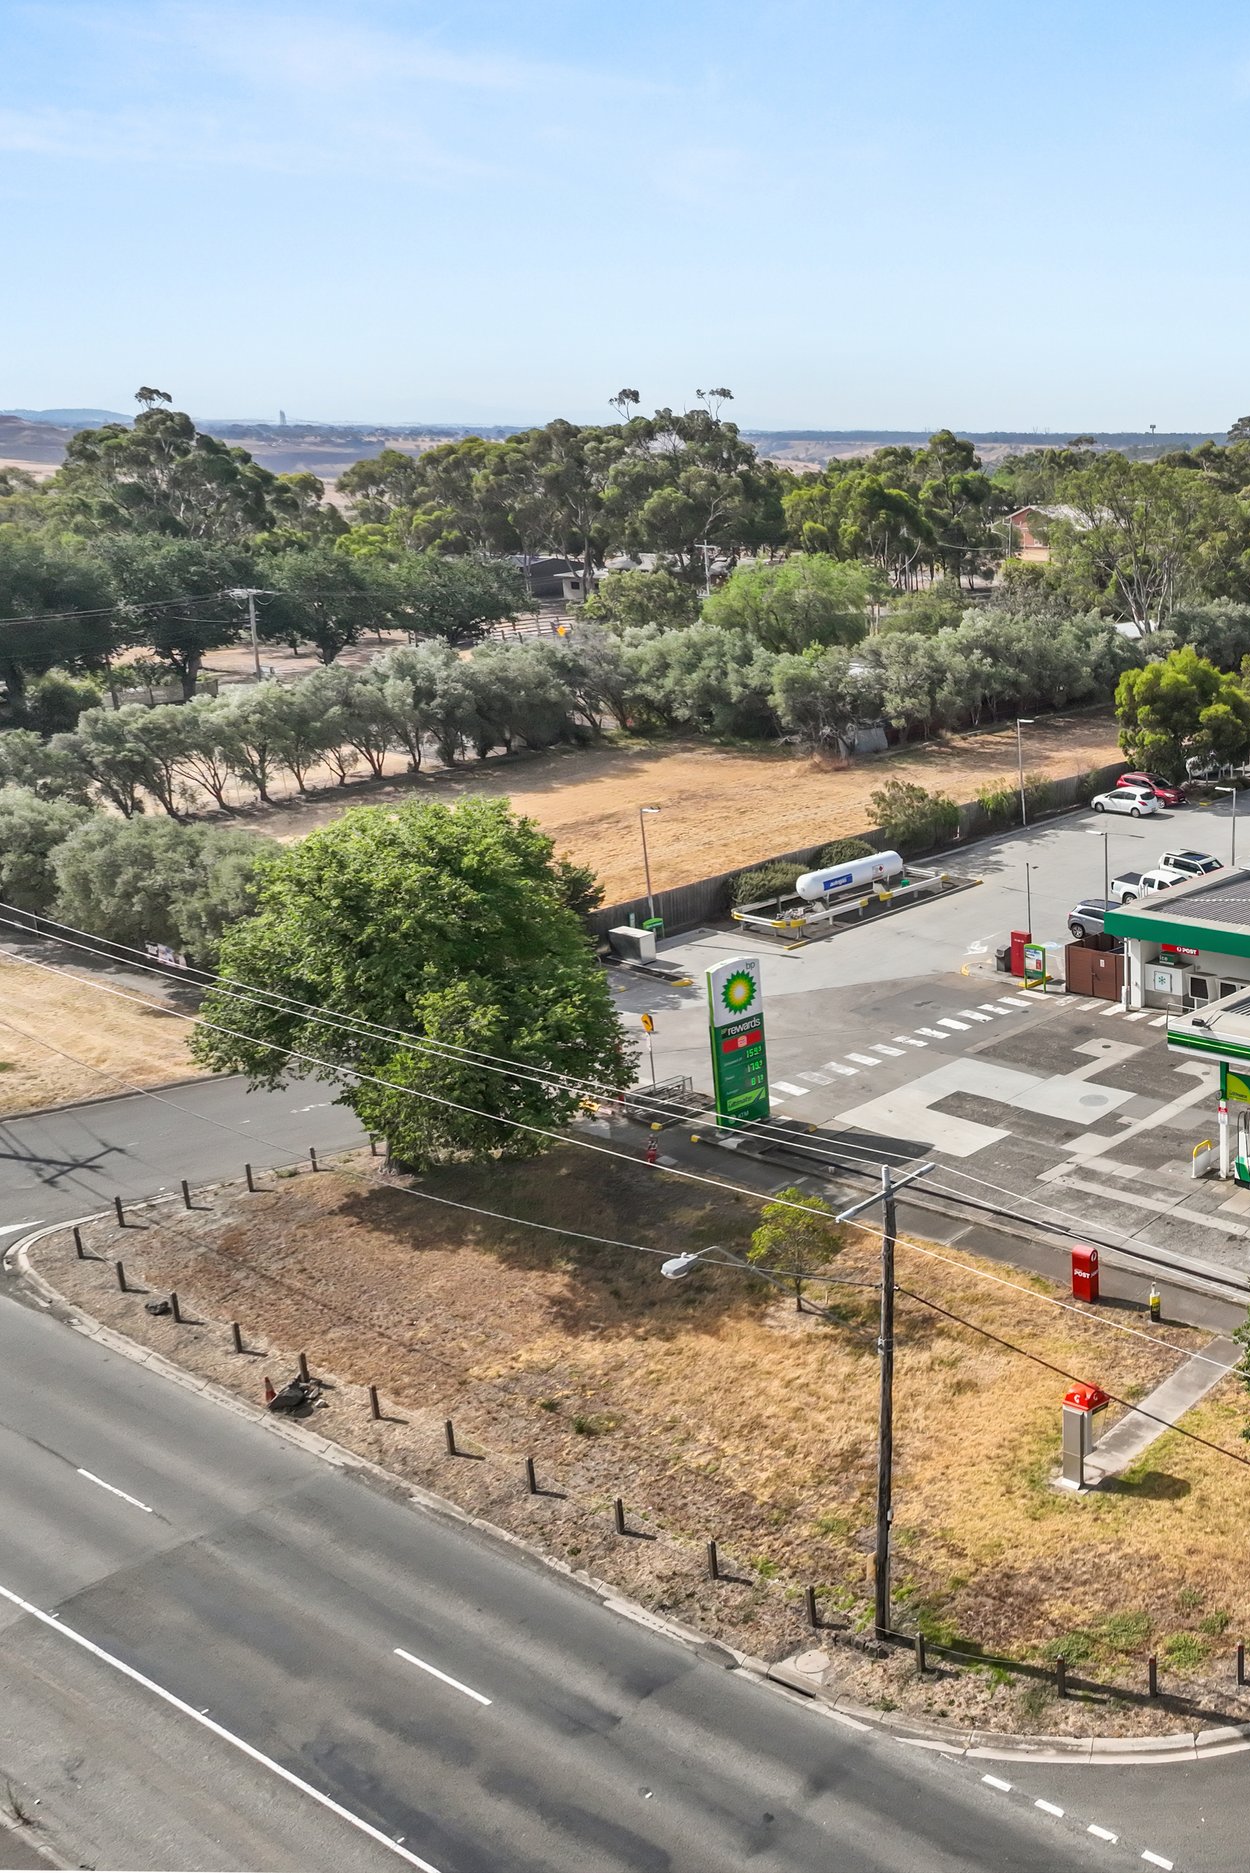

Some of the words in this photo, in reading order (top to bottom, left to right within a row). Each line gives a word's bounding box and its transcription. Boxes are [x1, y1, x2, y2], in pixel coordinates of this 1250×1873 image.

[1182, 947, 1197, 955] POST
[745, 961, 755, 970] bp
[728, 1017, 761, 1036] rewards
[1073, 1270, 1090, 1279] POST
